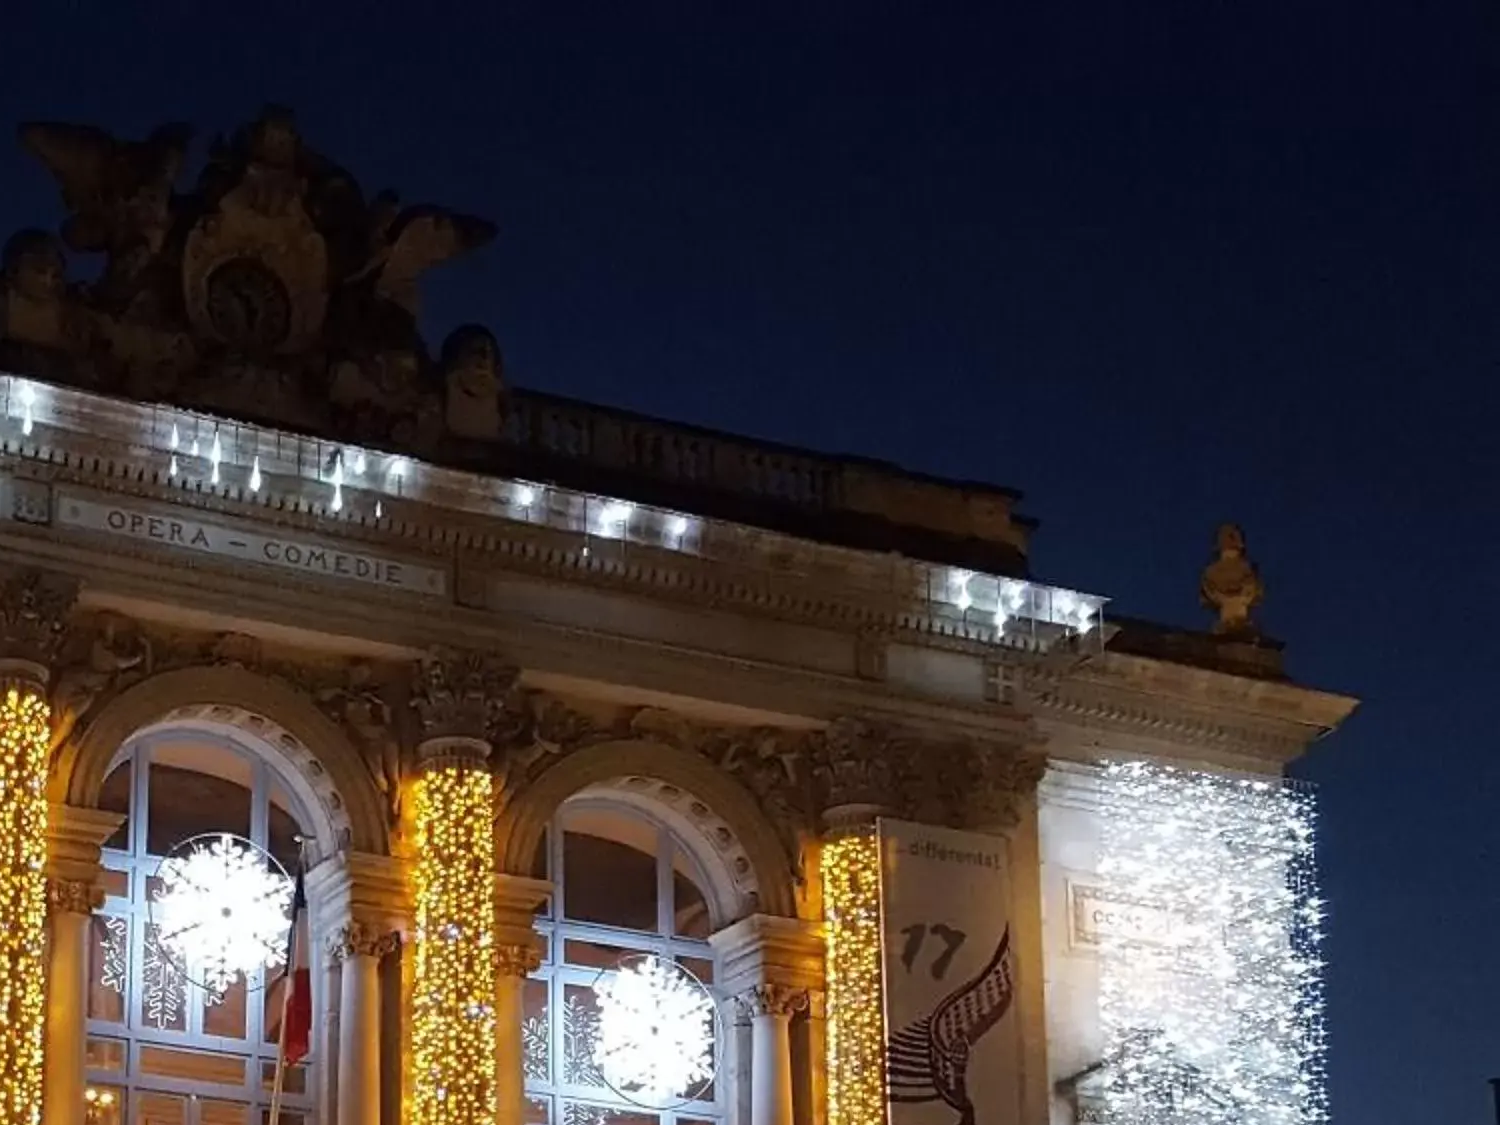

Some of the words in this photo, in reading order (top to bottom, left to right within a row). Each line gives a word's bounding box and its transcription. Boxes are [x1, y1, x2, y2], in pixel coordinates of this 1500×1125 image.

[107, 510, 210, 548] OPERA
[263, 541, 403, 584] COMEDIE
[900, 923, 968, 980] 17
